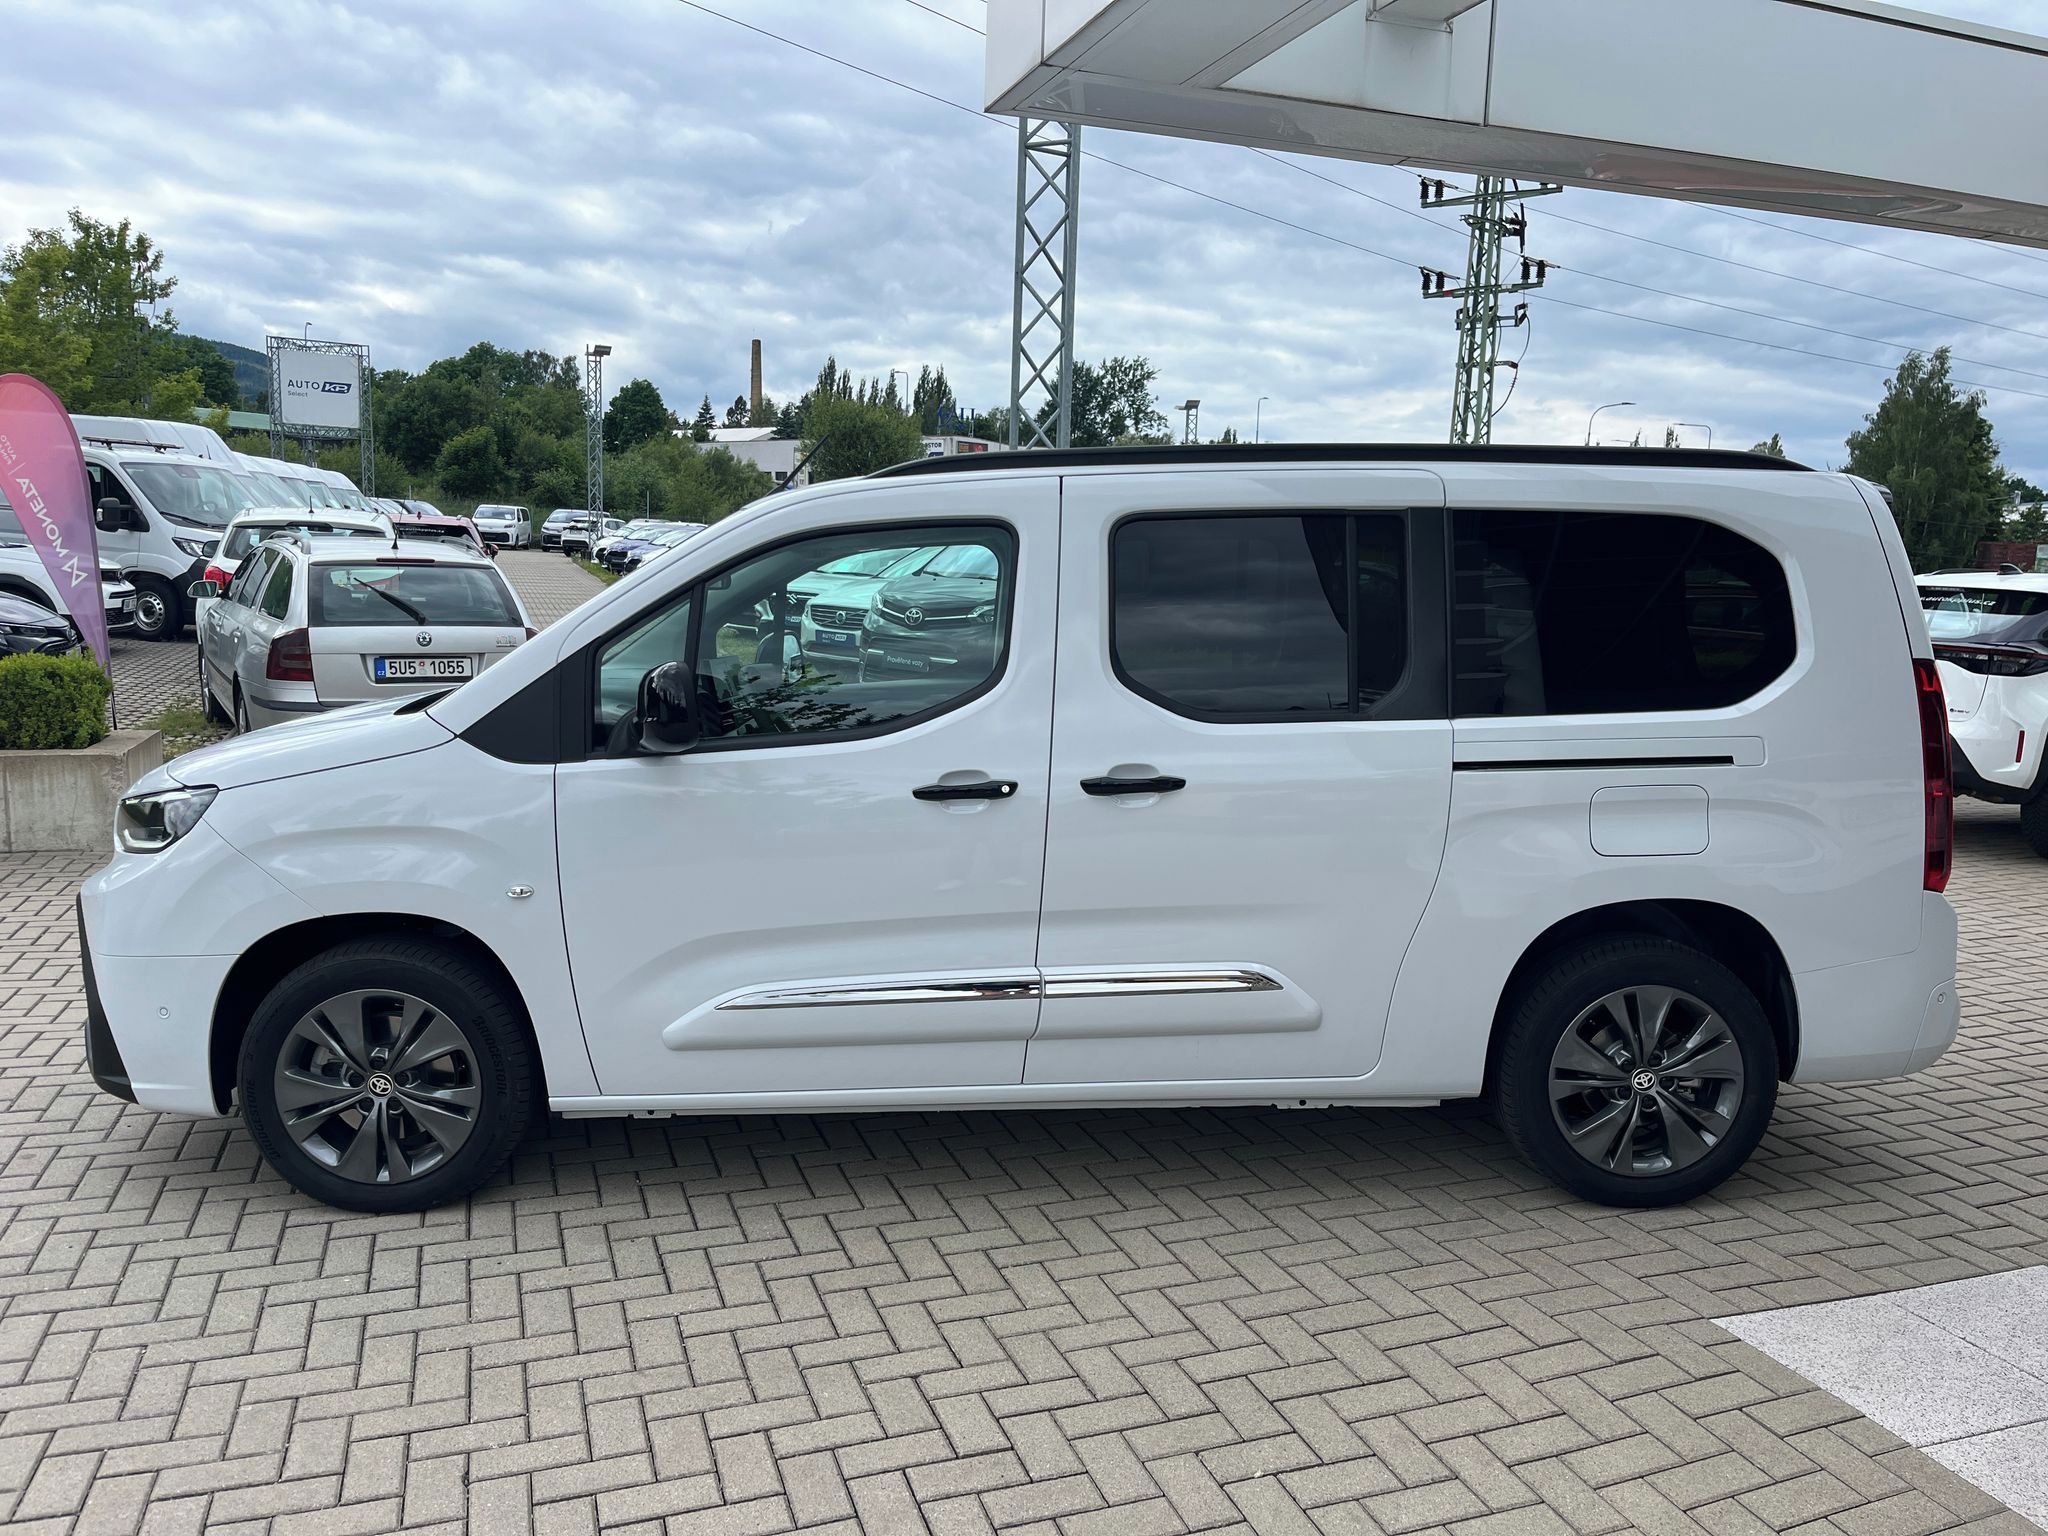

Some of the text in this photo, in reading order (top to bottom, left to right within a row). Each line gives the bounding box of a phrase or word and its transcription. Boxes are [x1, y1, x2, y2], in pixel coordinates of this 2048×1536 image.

[288, 379, 320, 390] AUTO
[287, 390, 308, 398] Select
[388, 660, 465, 676] 5U5 1055
